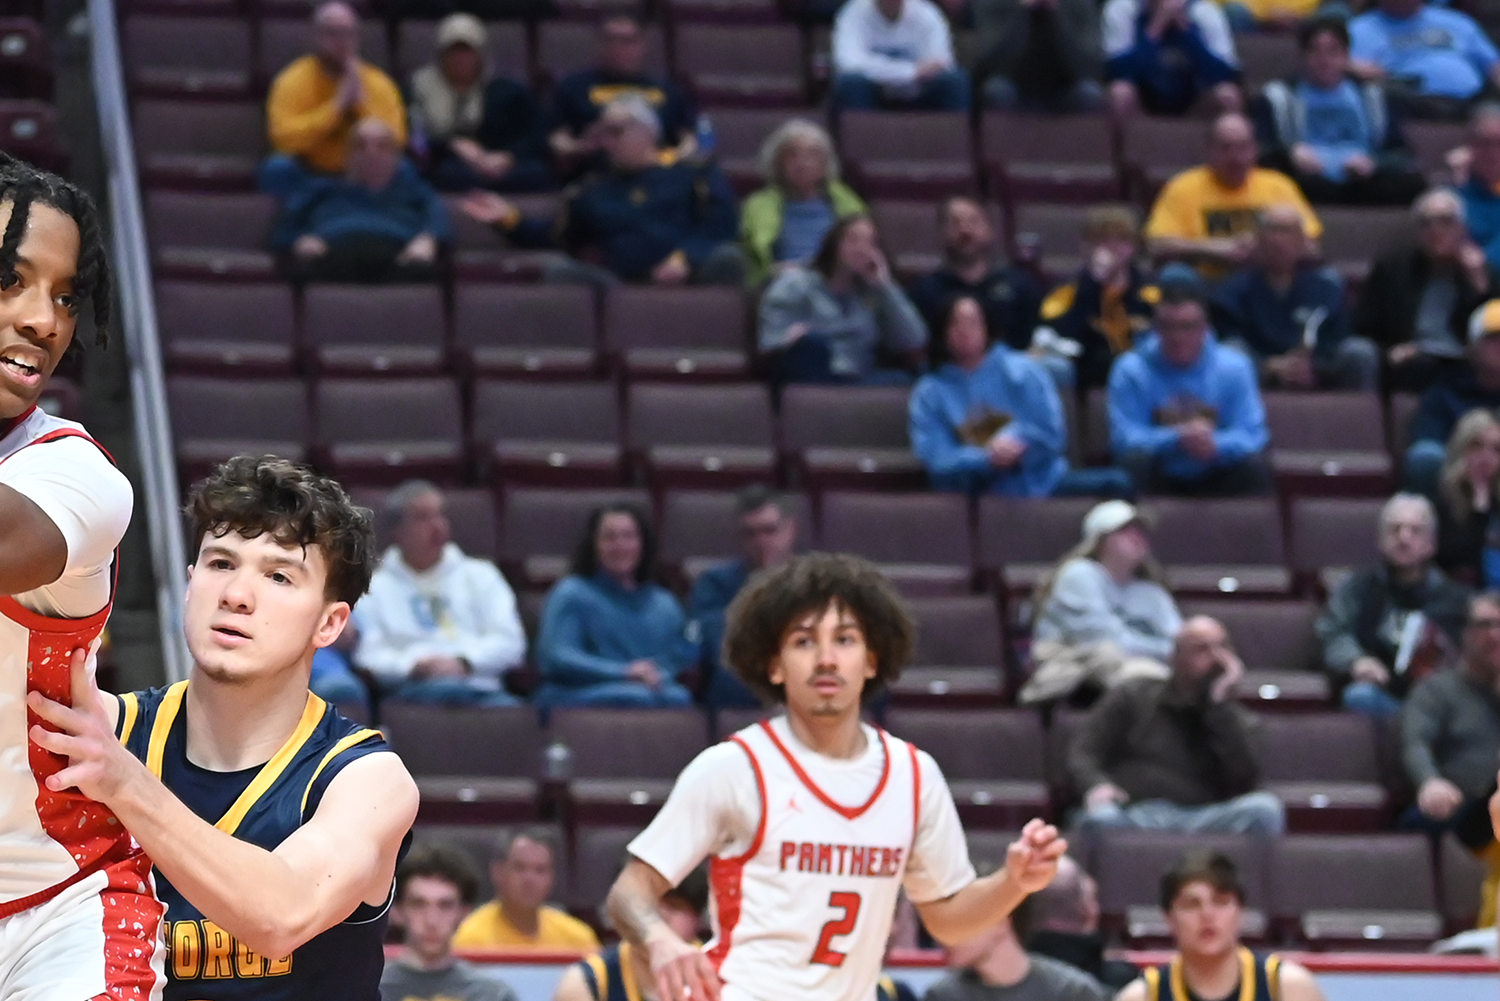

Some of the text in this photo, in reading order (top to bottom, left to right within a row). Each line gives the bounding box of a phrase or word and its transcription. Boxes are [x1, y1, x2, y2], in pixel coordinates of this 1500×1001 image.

[780, 841, 903, 878] PANTHERS
[163, 919, 294, 981] ORG
[808, 890, 862, 968] 2
